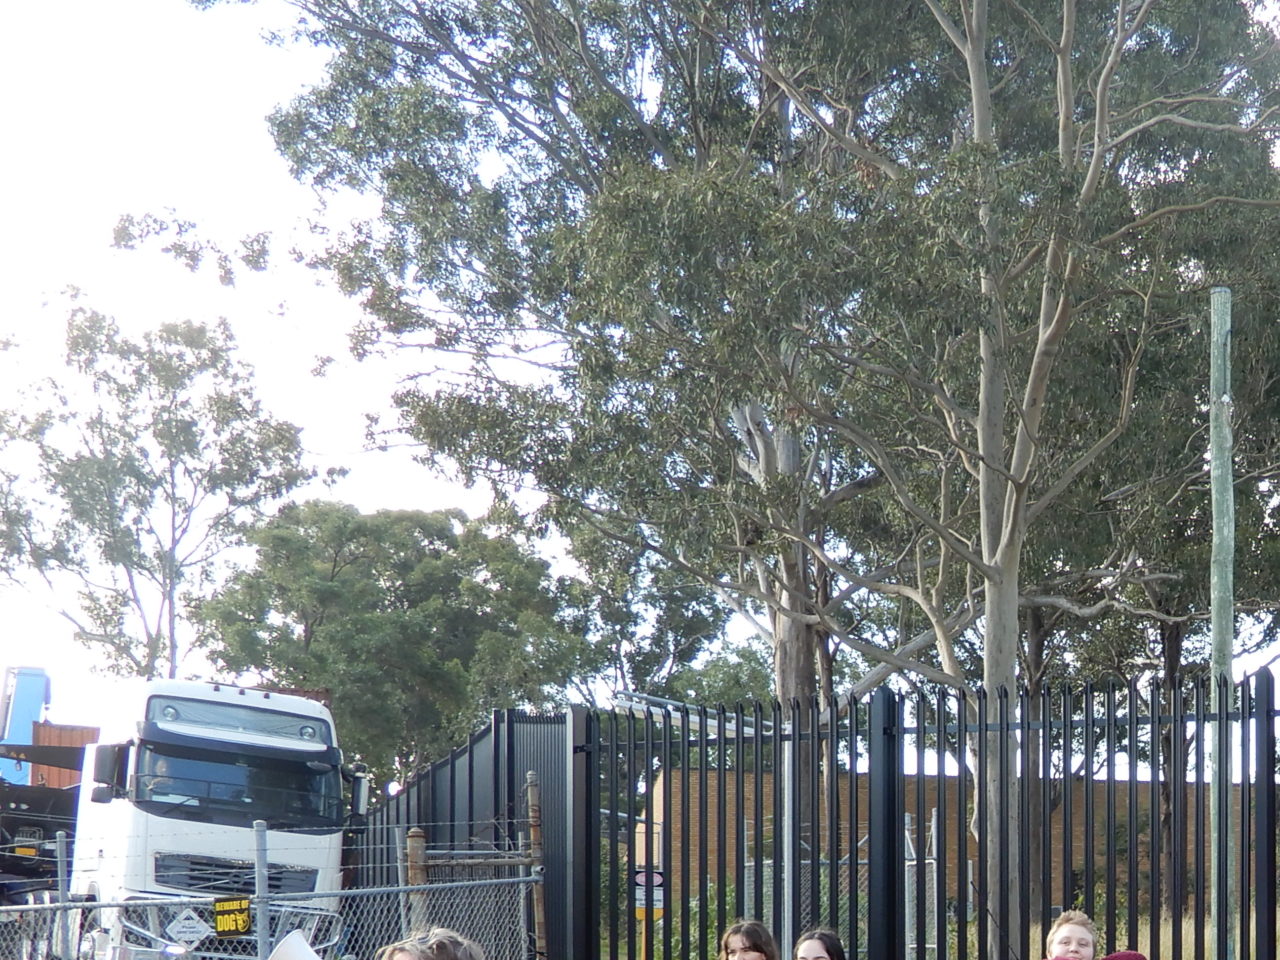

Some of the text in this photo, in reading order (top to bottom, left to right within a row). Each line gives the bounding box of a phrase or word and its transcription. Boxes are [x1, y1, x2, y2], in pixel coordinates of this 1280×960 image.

[215, 899, 249, 912] BEWARE OF
[216, 913, 237, 932] DOG
